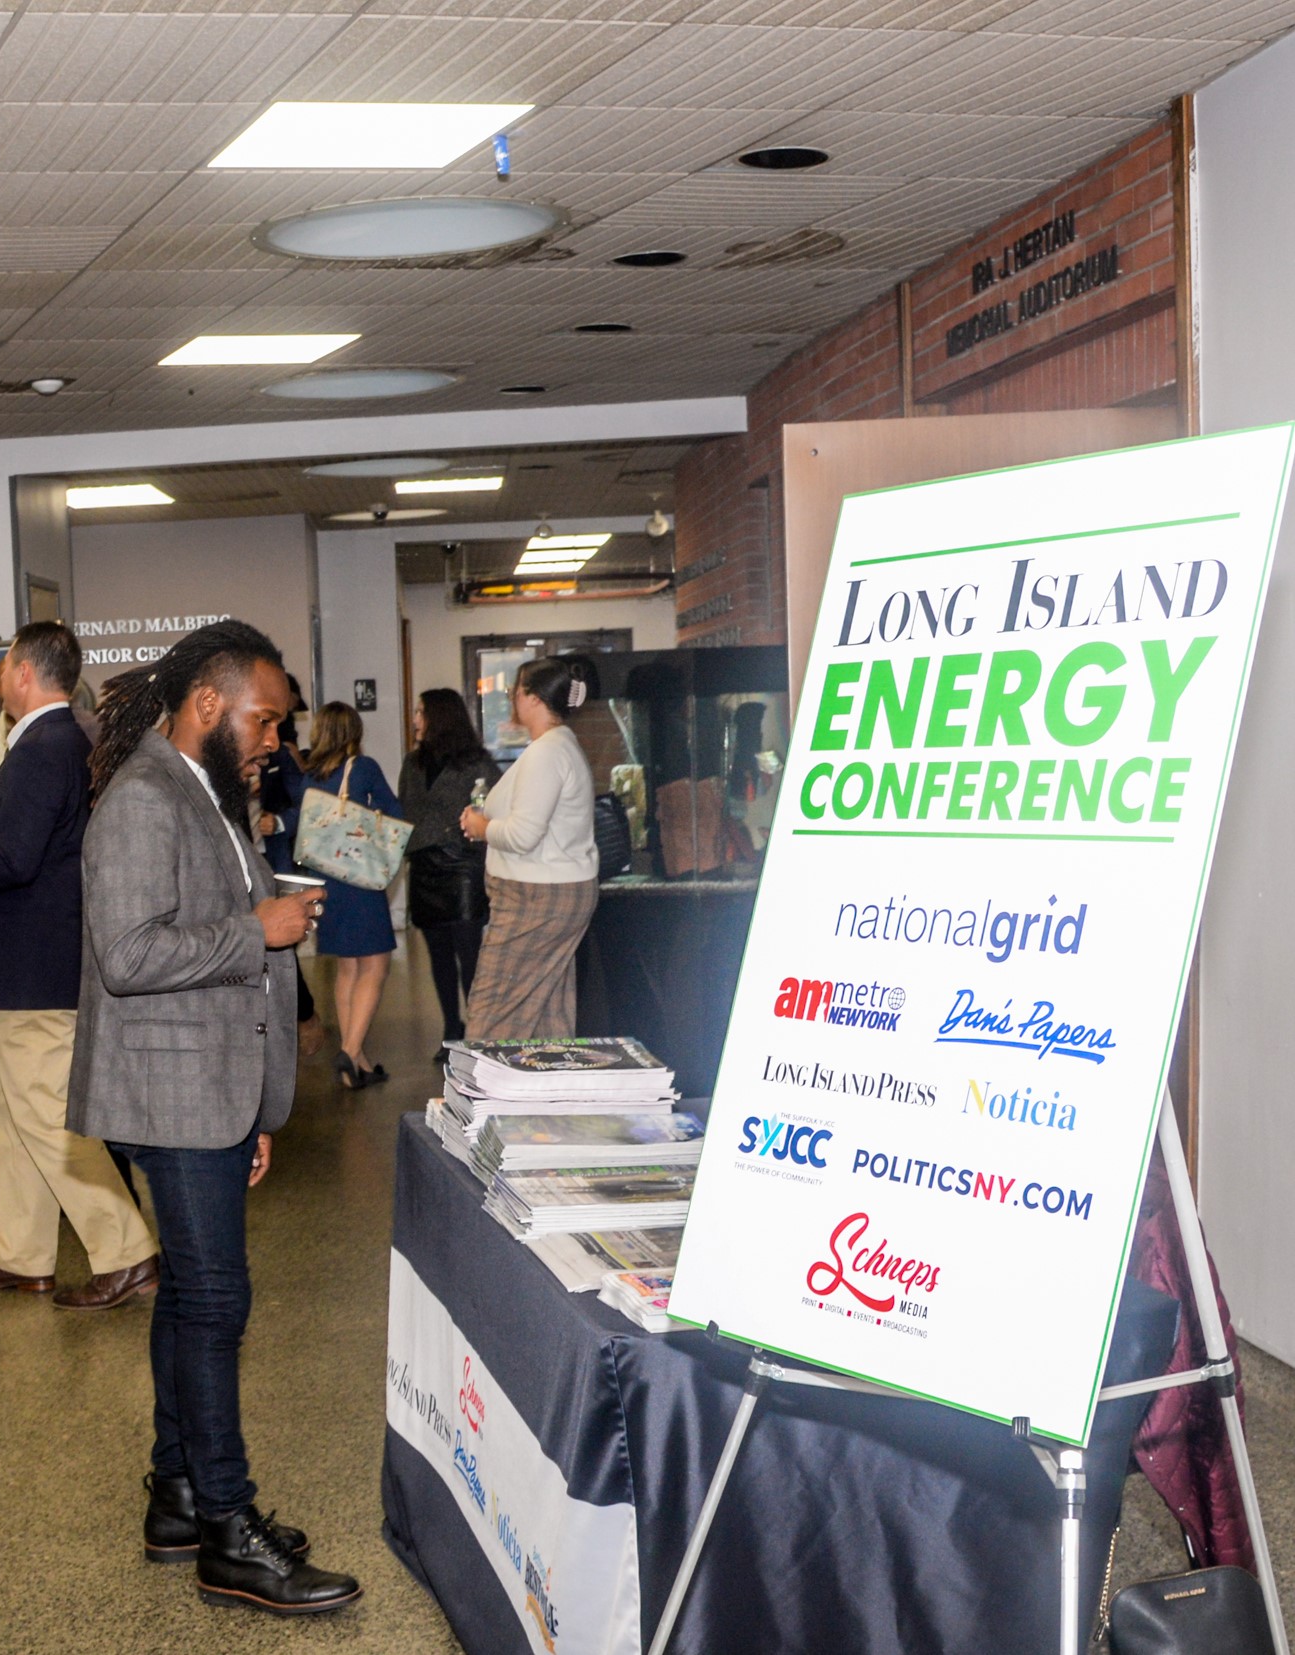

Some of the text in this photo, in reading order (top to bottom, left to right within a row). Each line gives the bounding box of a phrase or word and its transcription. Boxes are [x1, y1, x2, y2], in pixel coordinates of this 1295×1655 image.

[1019, 244, 1120, 323] AUDITORIUM
[74, 619, 141, 637] RNARD
[833, 558, 1228, 647] LONG ISLAND
[81, 646, 173, 664] ENIOR CEN
[810, 635, 1219, 751] ENERGY
[800, 756, 1192, 824] CONFERENCE
[835, 894, 1087, 963] nationalgrid
[939, 989, 1116, 1060] Dan's Papers
[762, 1056, 937, 1107] LONG ISLAND PRESS
[961, 1079, 1076, 1130] Noticia
[734, 1161, 746, 1171] THE
[747, 1164, 770, 1175] POWER
[782, 1172, 822, 1186] COMMUNITY
[852, 1149, 1093, 1220] POLITICSNY.COM
[807, 1212, 940, 1312] Schneps
[801, 1297, 928, 1339] PRINT DIGITAL EVENTS BROADCASTING
[899, 1300, 928, 1319] MEDIA
[490, 1488, 522, 1574] Noticia
